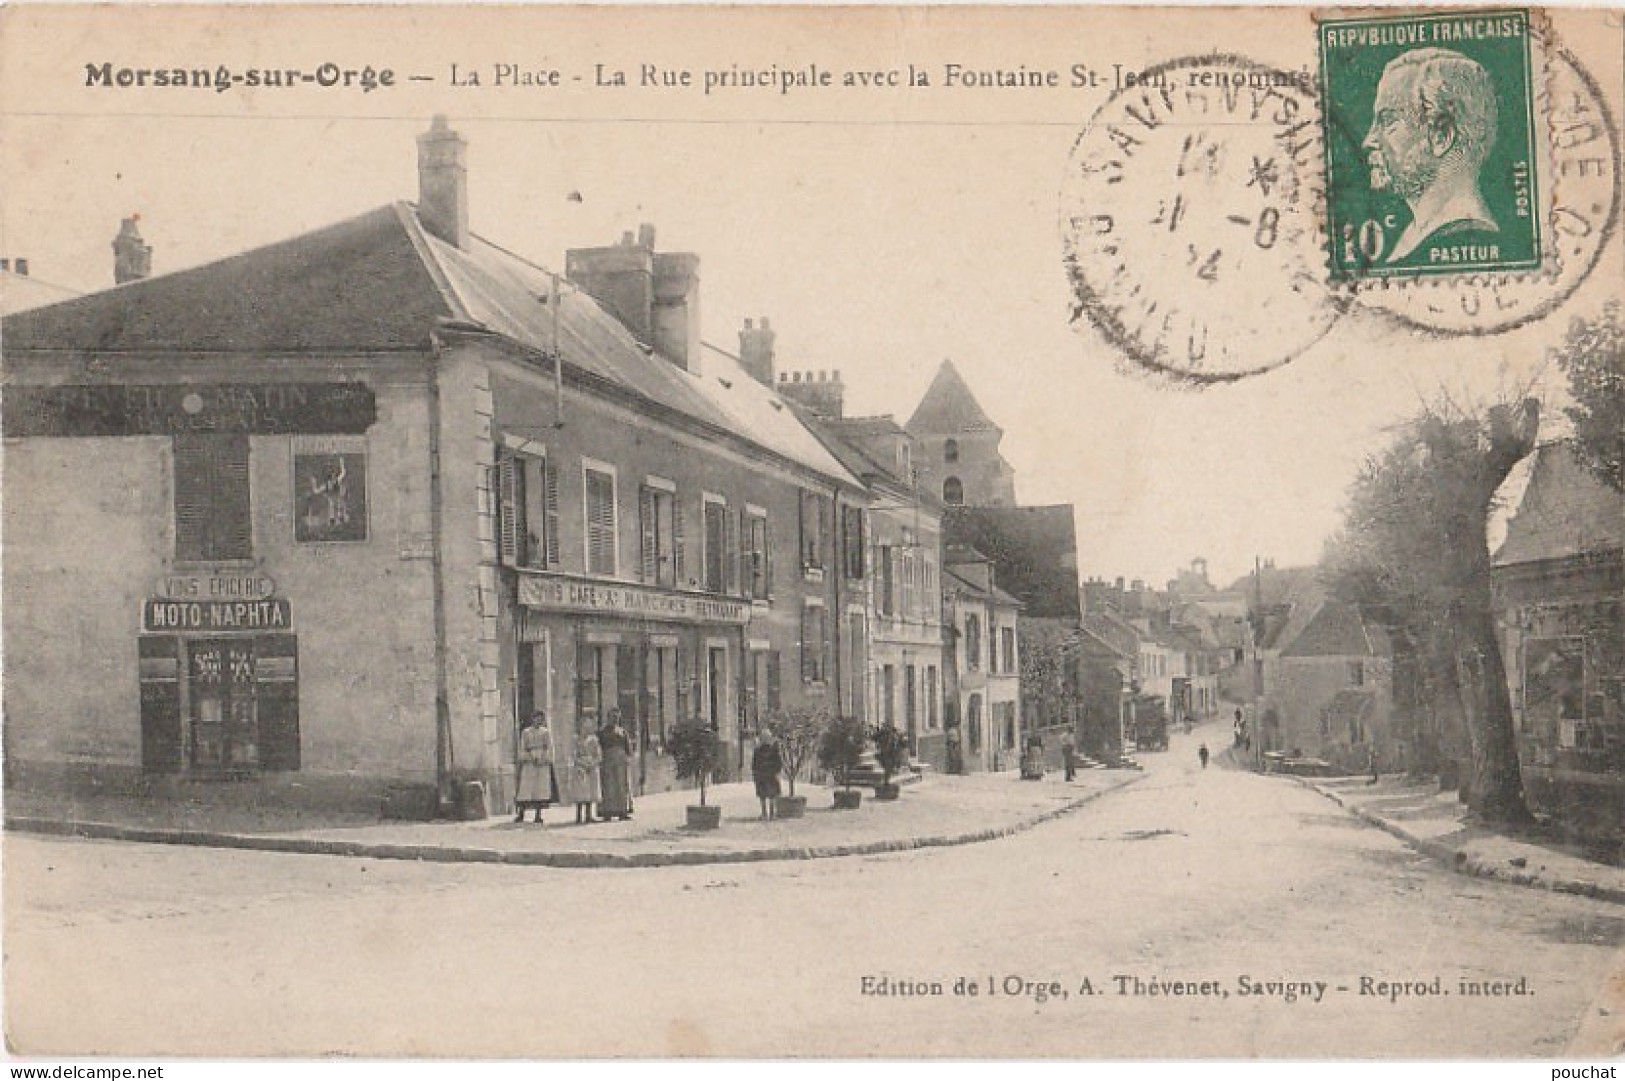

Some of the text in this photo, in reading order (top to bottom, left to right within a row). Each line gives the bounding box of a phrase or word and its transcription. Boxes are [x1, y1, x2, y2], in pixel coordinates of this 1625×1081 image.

[85, 62, 396, 94] Morsang-sur-Orge
[451, 63, 480, 87] La
[495, 63, 560, 87] Place
[595, 63, 626, 87] La
[641, 64, 691, 87] Rue
[704, 63, 831, 95] principale
[843, 71, 899, 87] avec
[909, 64, 930, 87] la
[944, 63, 1058, 87] Fontaine
[1071, 63, 1176, 91] St-Jean,
[1429, 245, 1500, 263] PASTEUR
[860, 975, 943, 996] Edition
[952, 975, 979, 996] de
[1079, 975, 1104, 996] A.
[1112, 974, 1230, 1000] Thévenet,
[1236, 975, 1328, 1003] Savigny
[1358, 975, 1451, 1003] Reprod.
[1458, 975, 1536, 997] interd.
